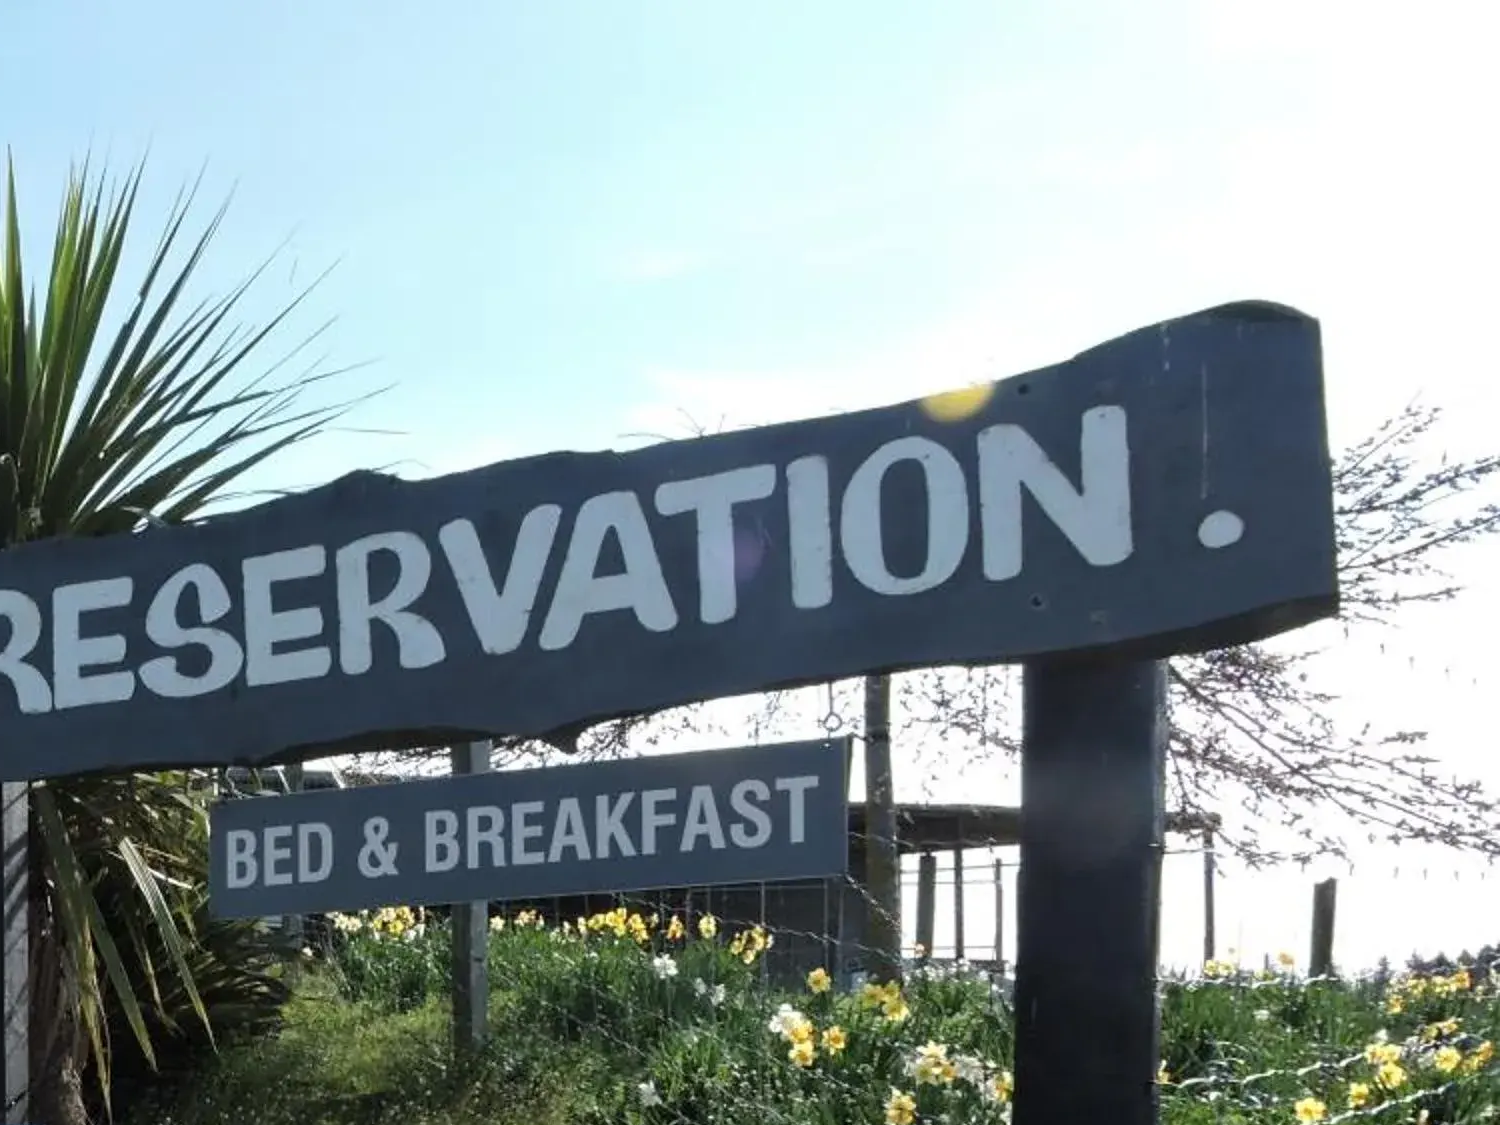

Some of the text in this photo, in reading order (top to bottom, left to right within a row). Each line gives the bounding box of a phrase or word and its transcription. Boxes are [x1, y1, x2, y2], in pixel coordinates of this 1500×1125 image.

[225, 774, 820, 889] BED & BREAKFAST
